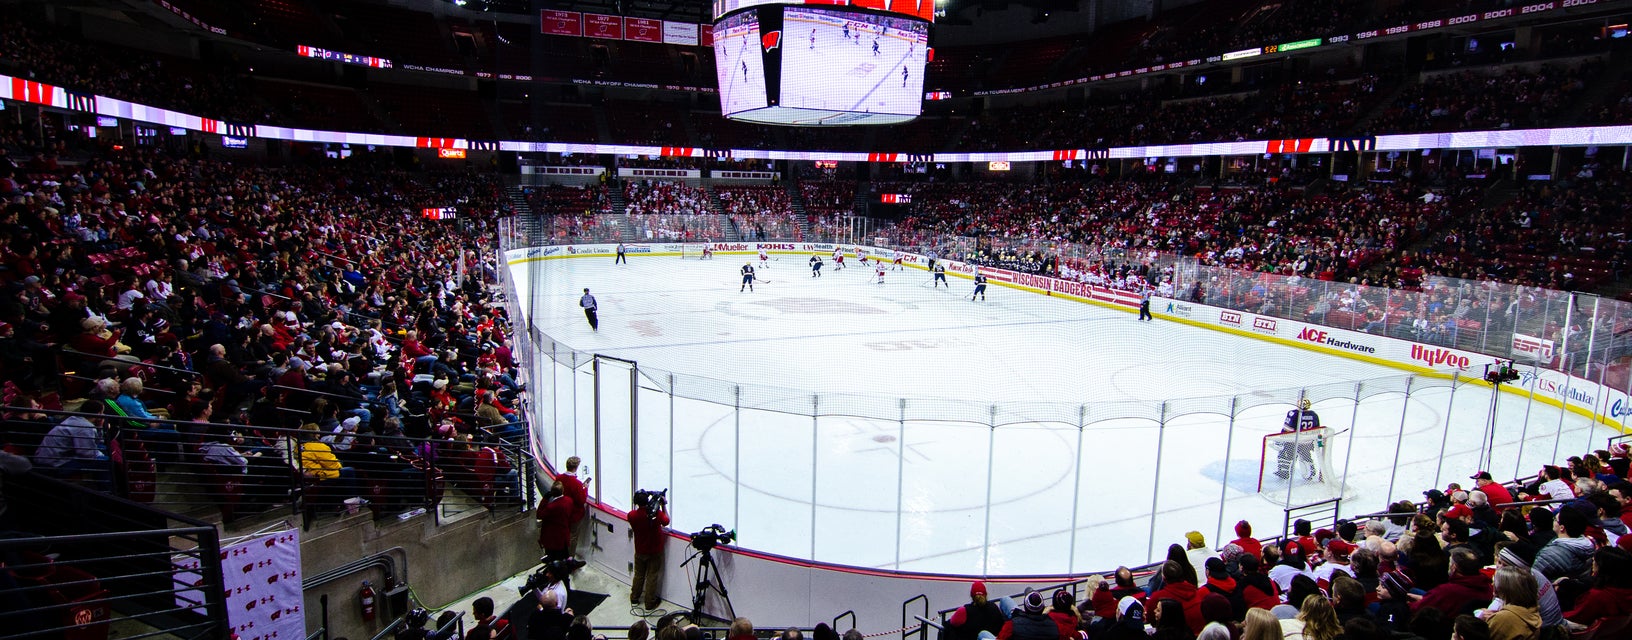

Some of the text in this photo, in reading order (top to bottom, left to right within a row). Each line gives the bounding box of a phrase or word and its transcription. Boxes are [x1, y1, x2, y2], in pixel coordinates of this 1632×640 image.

[1329, 35, 1349, 43] 1993
[1356, 30, 1377, 39] 1994
[1385, 25, 1408, 35] 1995
[1417, 20, 1441, 30] 1998
[1448, 14, 1476, 25] 2000
[1484, 9, 1512, 20] 2001
[1521, 2, 1553, 14] 2004
[425, 66, 464, 75] CHAMPIONS
[441, 148, 463, 157] Quartz
[720, 243, 749, 251] Mueller
[1012, 271, 1092, 299] WISCONSIN BADGERS
[1221, 312, 1241, 323] BTN
[1254, 318, 1276, 330] BTN
[1297, 326, 1375, 354] ACE Hardware
[1513, 338, 1551, 359] ESPN
